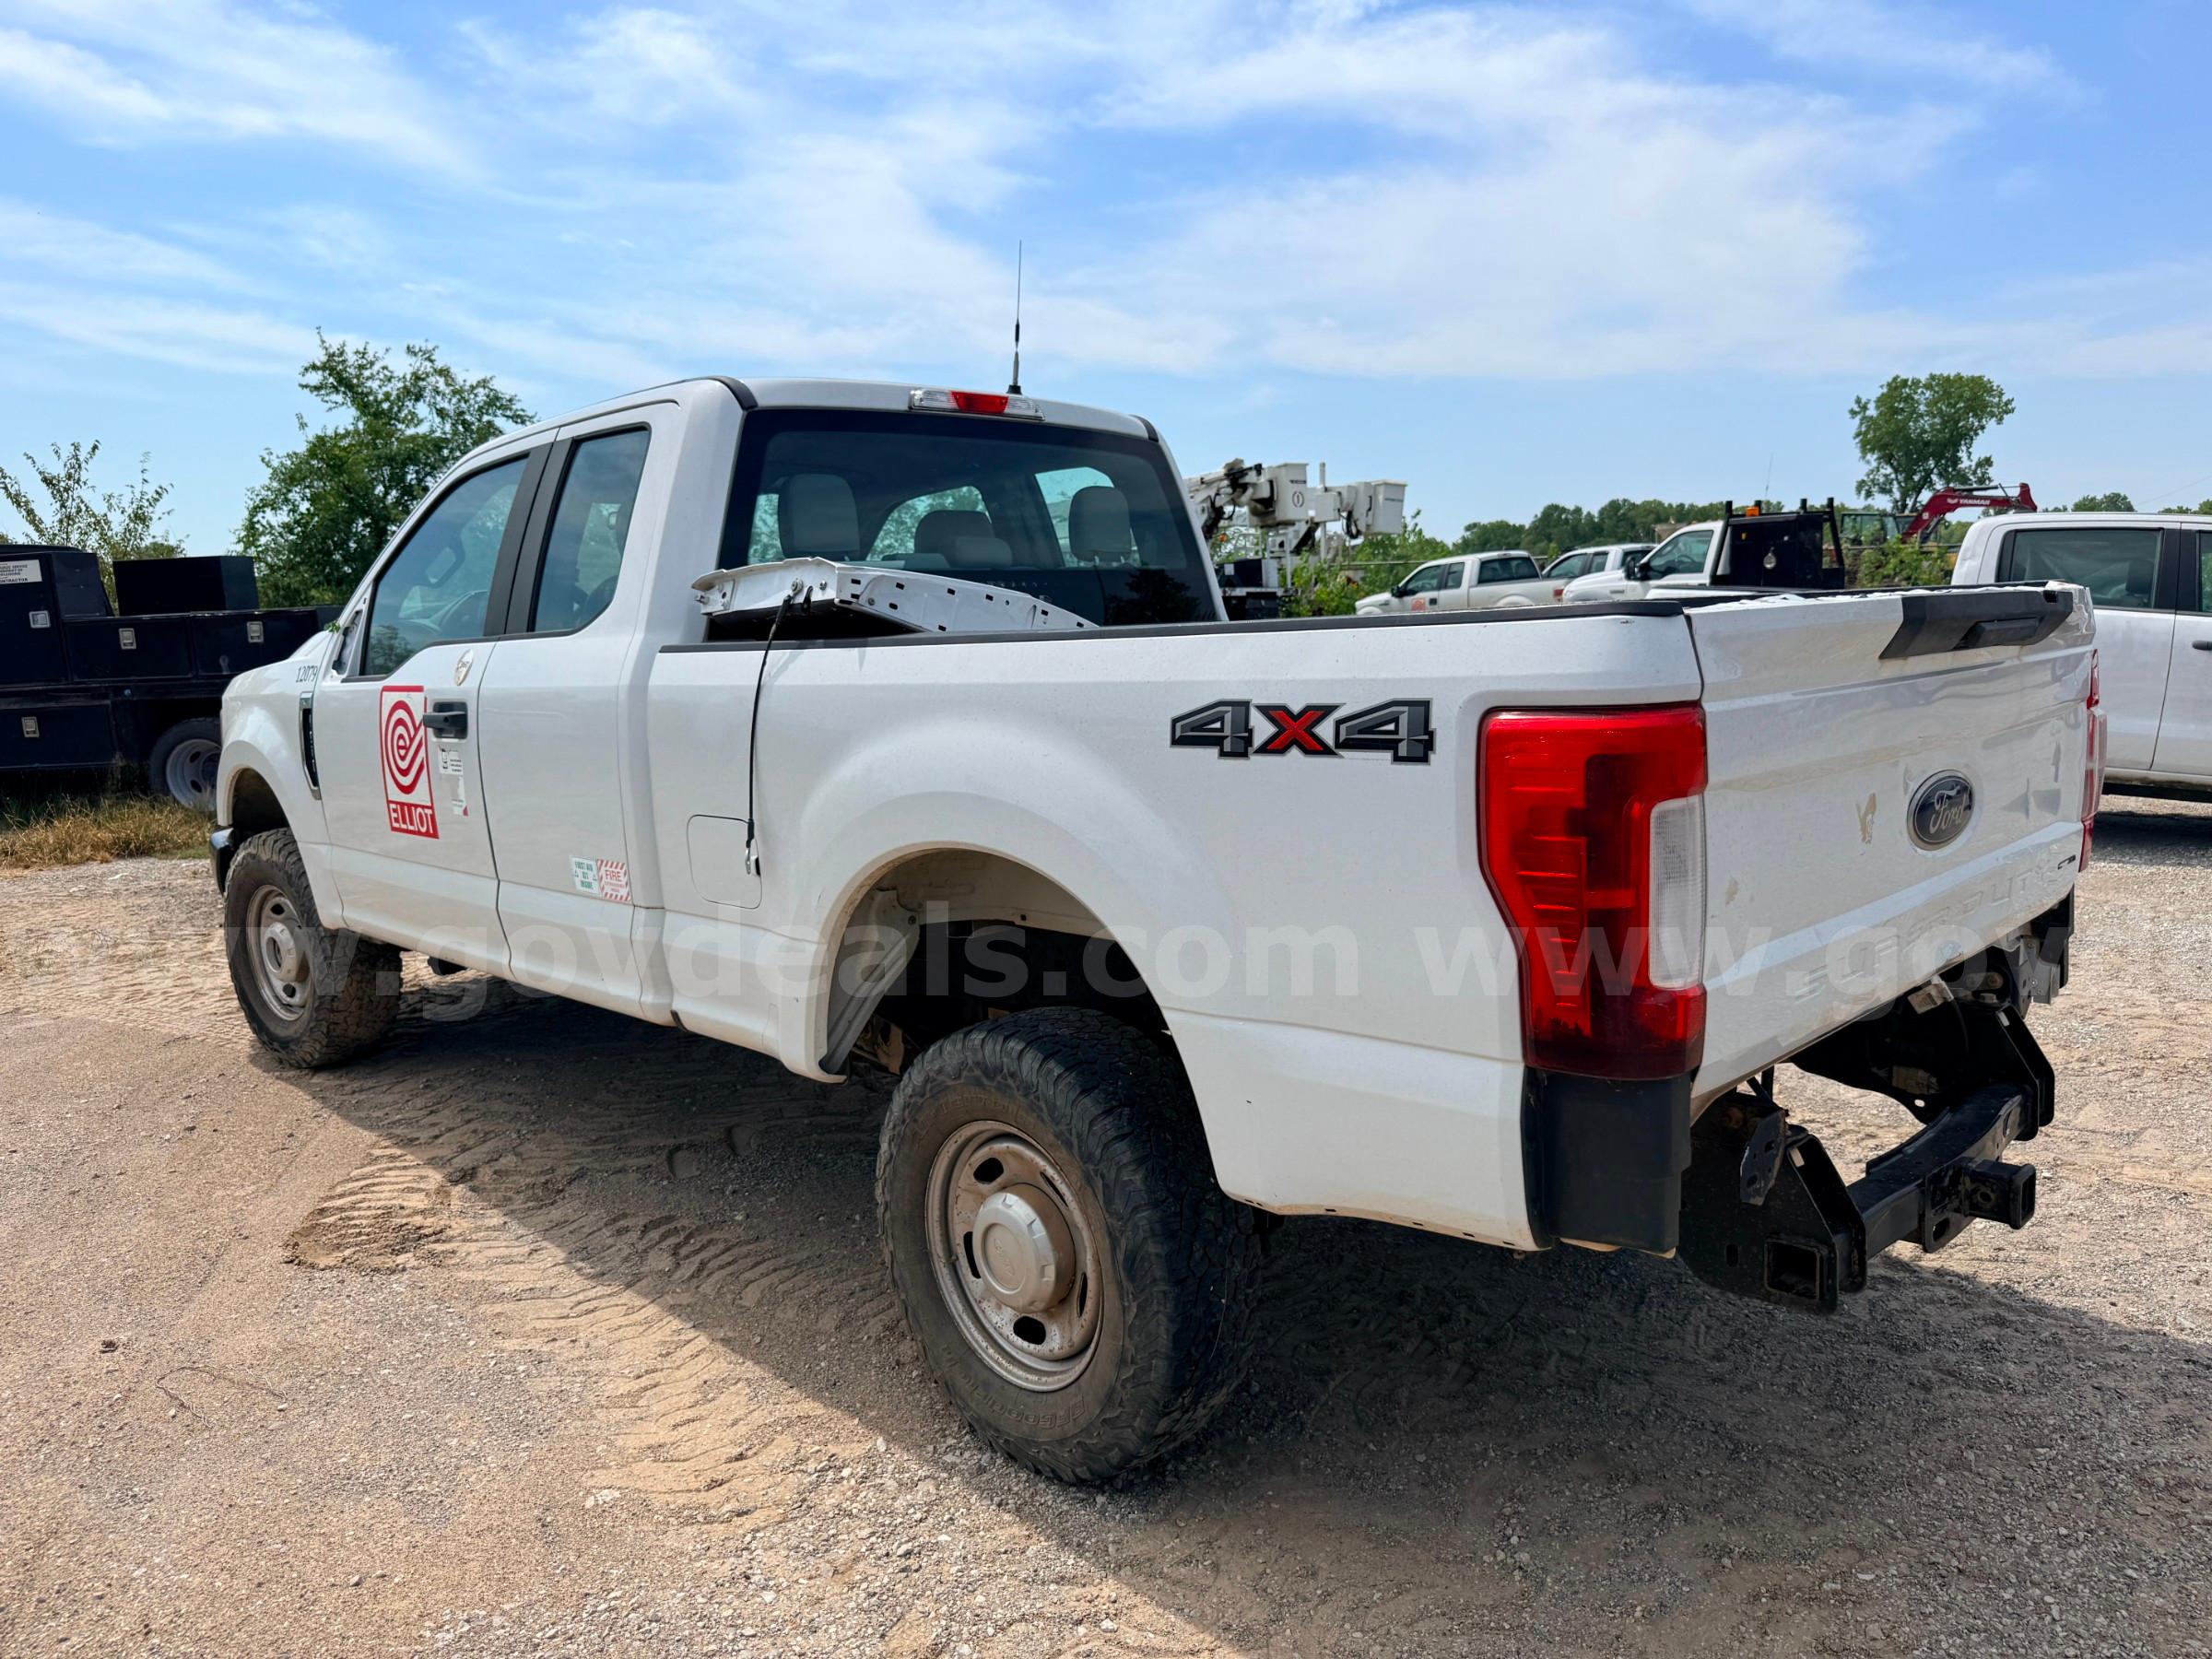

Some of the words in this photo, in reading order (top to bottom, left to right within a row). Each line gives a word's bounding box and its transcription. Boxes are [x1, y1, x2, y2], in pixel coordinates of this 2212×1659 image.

[1959, 498, 1991, 506] YANMAR
[295, 665, 319, 683] 12079
[1927, 783, 1967, 834] Ford
[390, 804, 435, 835] ELLIOT
[605, 870, 621, 881] FIRE
